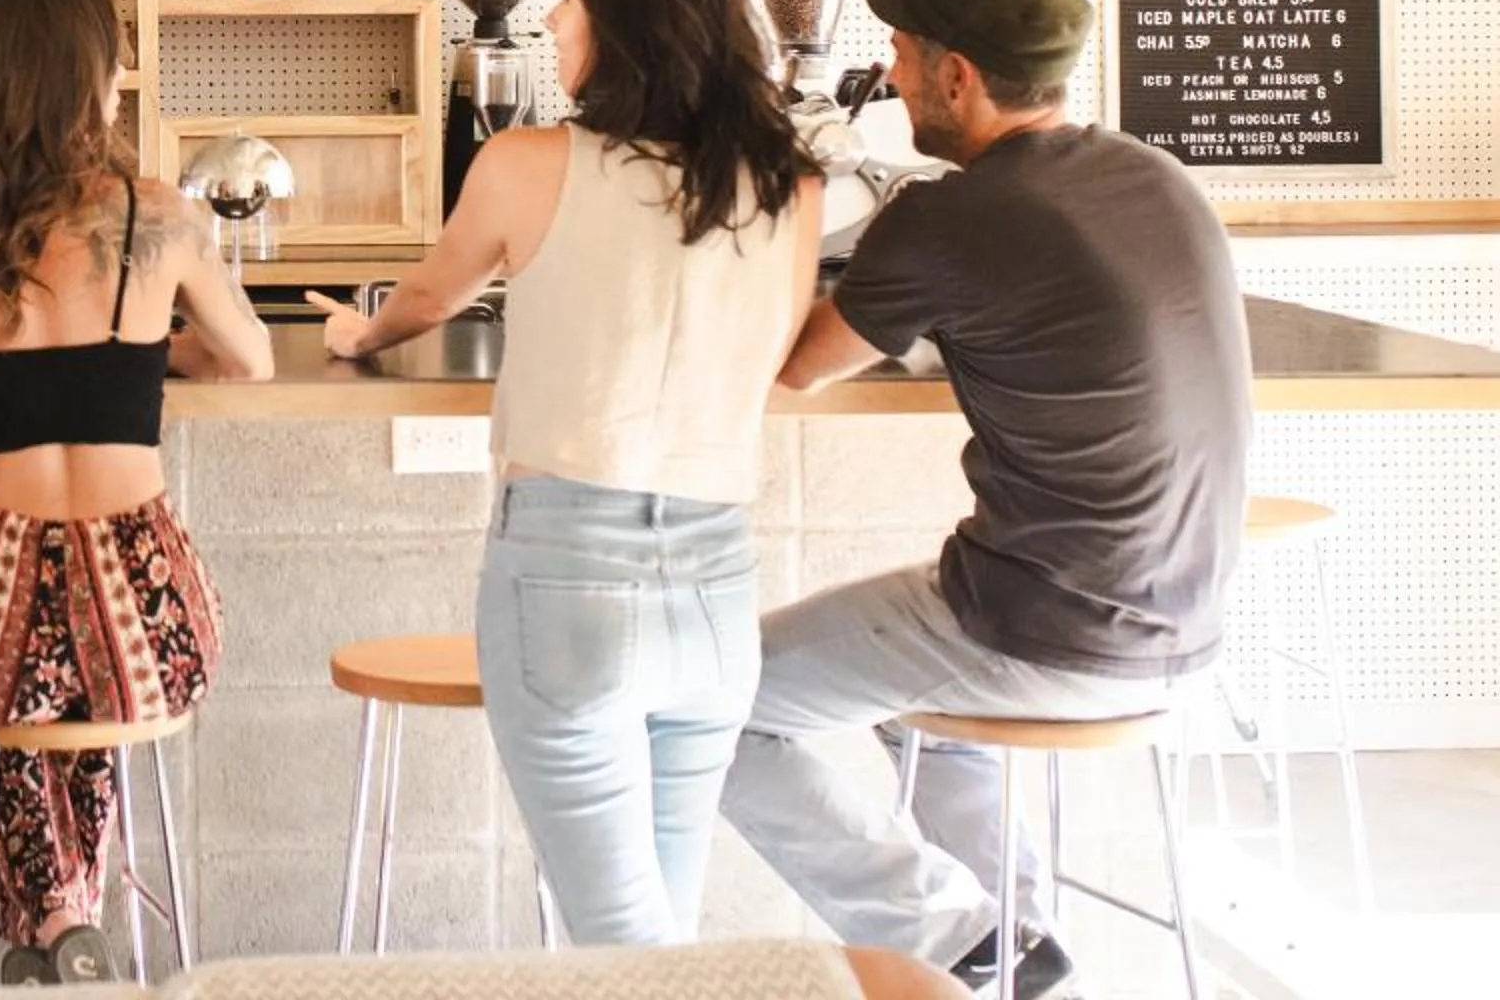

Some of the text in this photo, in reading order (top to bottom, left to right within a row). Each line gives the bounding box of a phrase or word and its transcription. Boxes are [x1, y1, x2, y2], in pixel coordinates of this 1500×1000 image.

[1137, 9, 1347, 26] ICED MAPLE OAT LATTE 6
[1136, 35, 1174, 50] CHAI
[1242, 33, 1312, 49] MATCHA
[1331, 33, 1342, 48] 6
[1216, 55, 1285, 71] TEA 4.5
[1142, 70, 1344, 87] ICED PEACH OR HIBISCUS 5
[1181, 85, 1327, 102] JASMINE LEMONADE 6
[1191, 113, 1217, 126] HOT
[1229, 113, 1301, 125] CHOCOLATE
[1180, 132, 1226, 144] DRINKS
[1229, 131, 1275, 144] PRICED
[1279, 131, 1295, 143] AS
[1189, 144, 1234, 157] EXTRA
[1241, 143, 1282, 156] SHOTS
